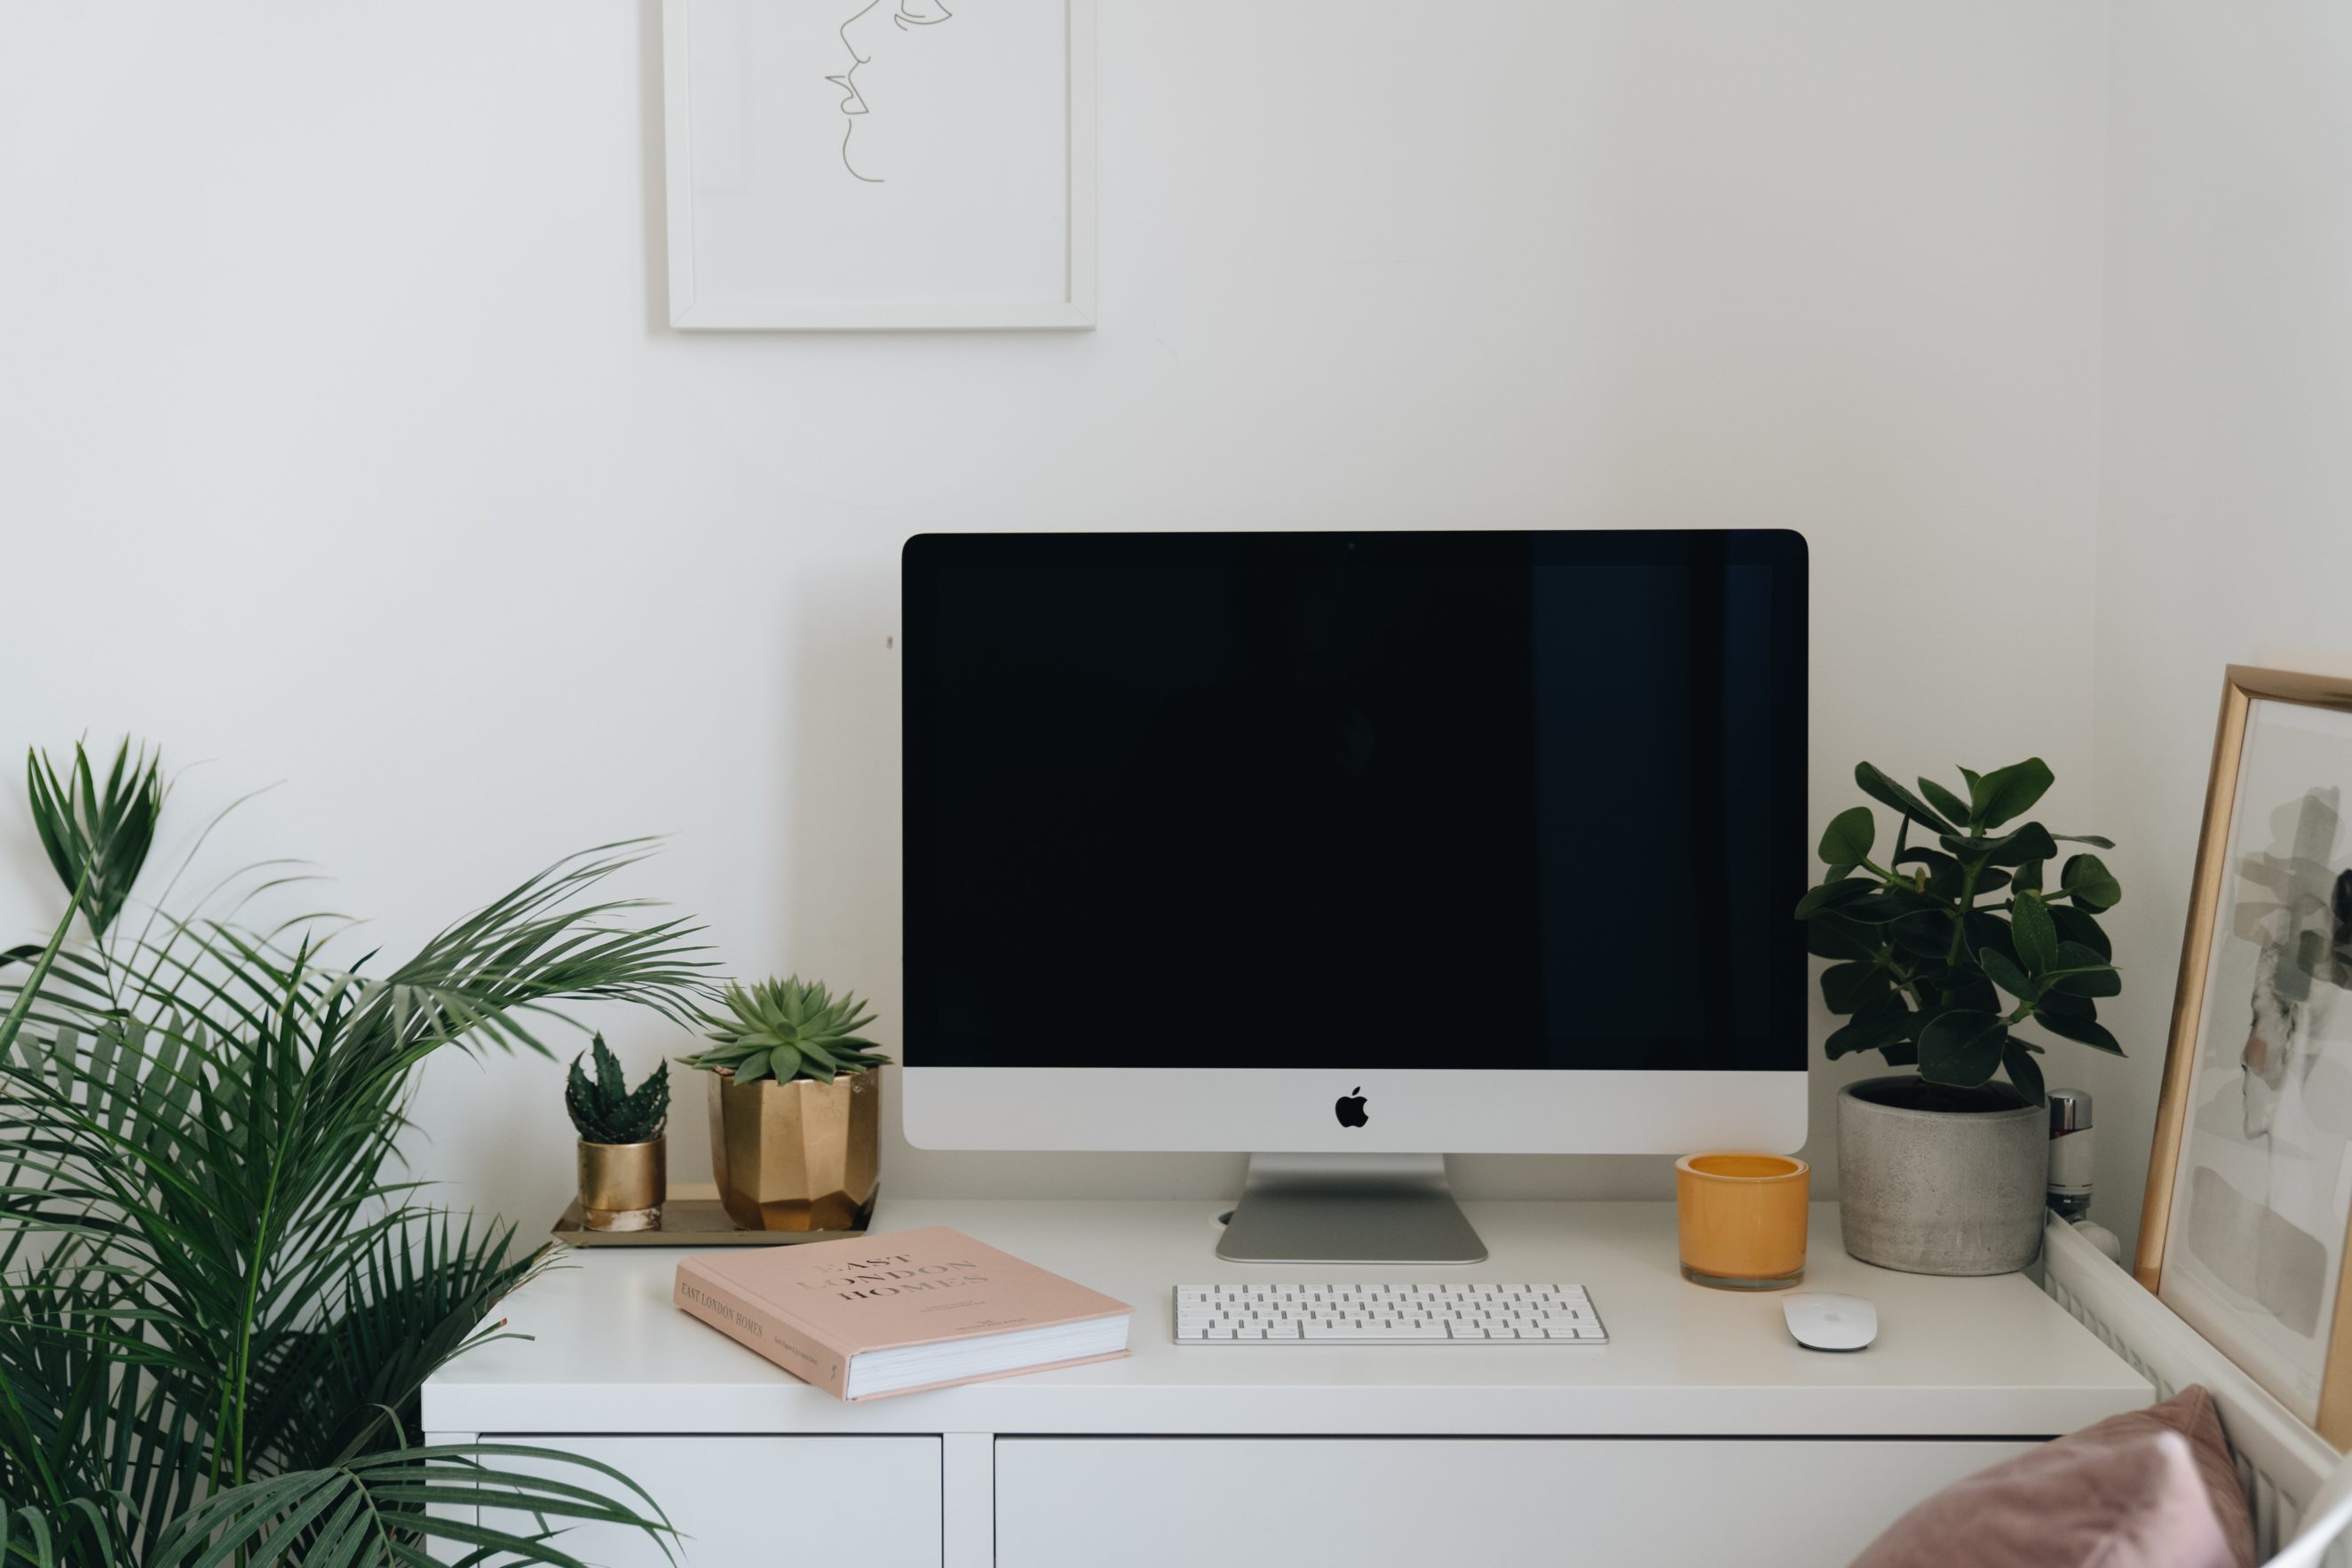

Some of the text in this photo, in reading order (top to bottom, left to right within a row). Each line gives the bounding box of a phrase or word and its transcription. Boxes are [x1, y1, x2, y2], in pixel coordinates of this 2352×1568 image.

[796, 1260, 978, 1290] LONDON
[812, 1254, 911, 1273] EAST
[835, 1274, 989, 1300] HOMES
[681, 1282, 764, 1337] EAST LONDON HOMES
